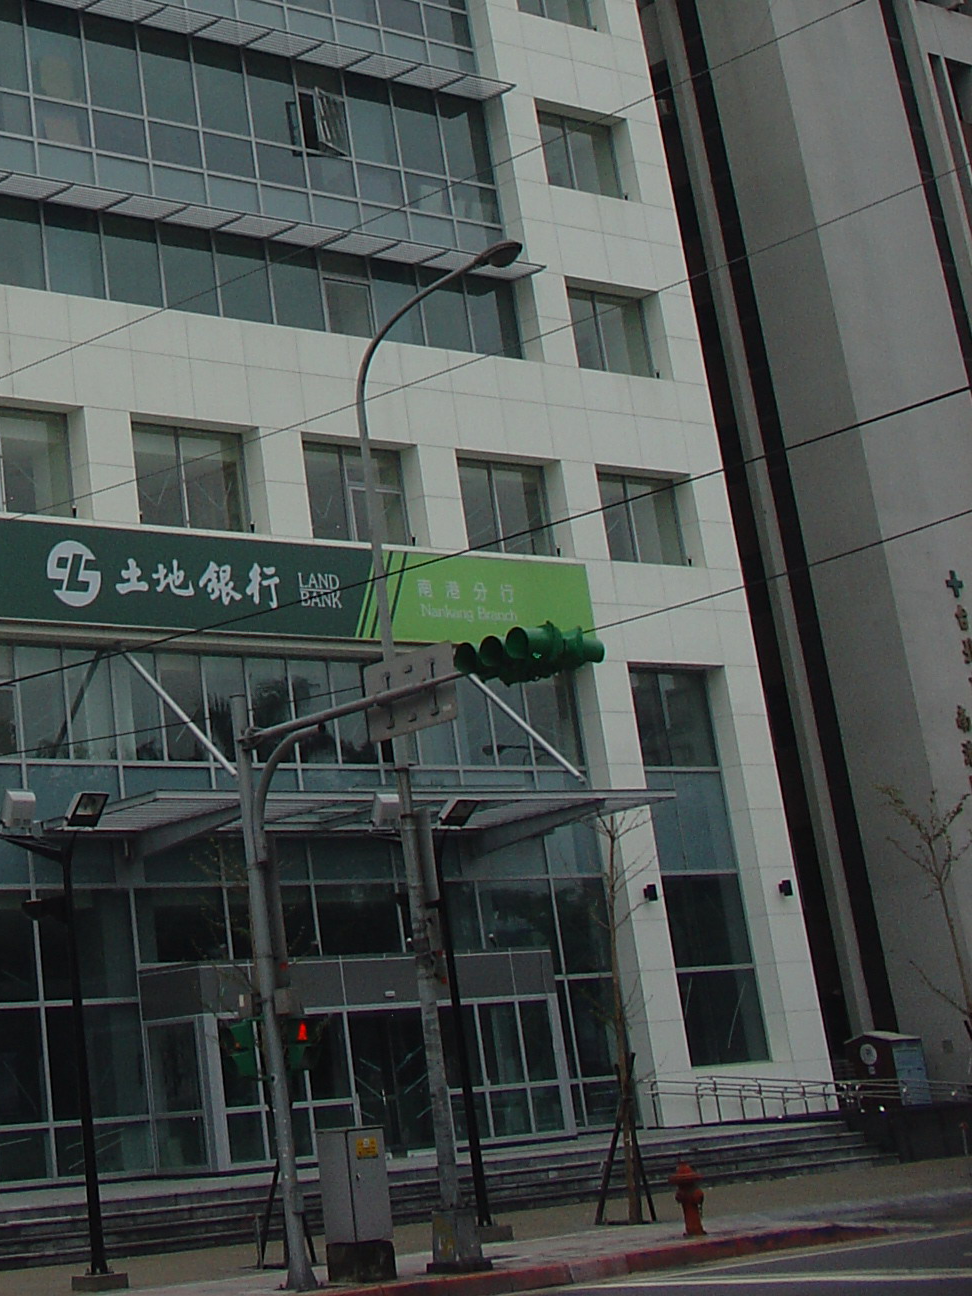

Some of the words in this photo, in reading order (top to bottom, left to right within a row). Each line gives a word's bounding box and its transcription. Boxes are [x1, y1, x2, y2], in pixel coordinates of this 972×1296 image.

[115, 557, 280, 609] 土地銀行
[297, 572, 340, 590] LAND
[299, 589, 342, 609] BANK
[477, 606, 517, 622] Branch
